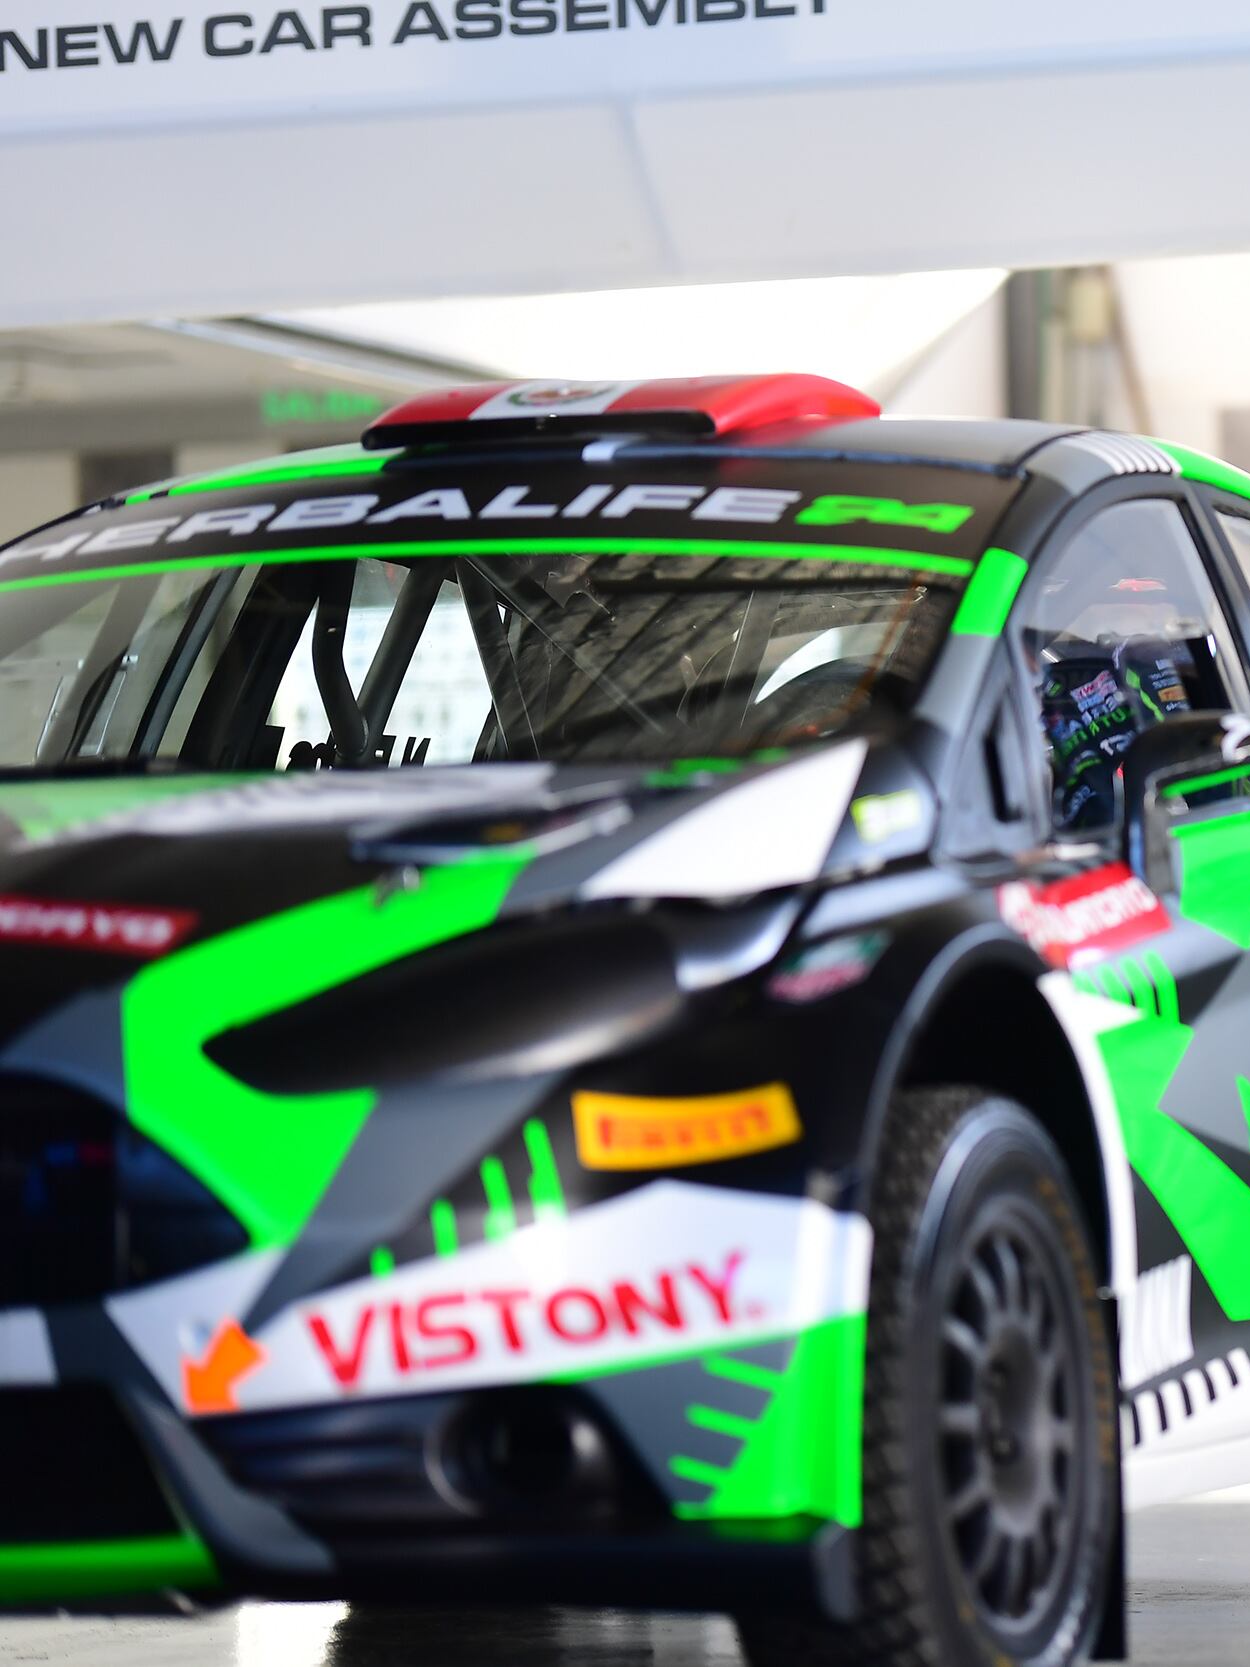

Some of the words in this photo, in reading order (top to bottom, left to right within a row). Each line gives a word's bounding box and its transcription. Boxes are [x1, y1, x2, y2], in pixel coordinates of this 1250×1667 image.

[0, 18, 184, 71] NEW
[204, 6, 372, 57] CAR
[305, 1250, 744, 1396] VISTONY
